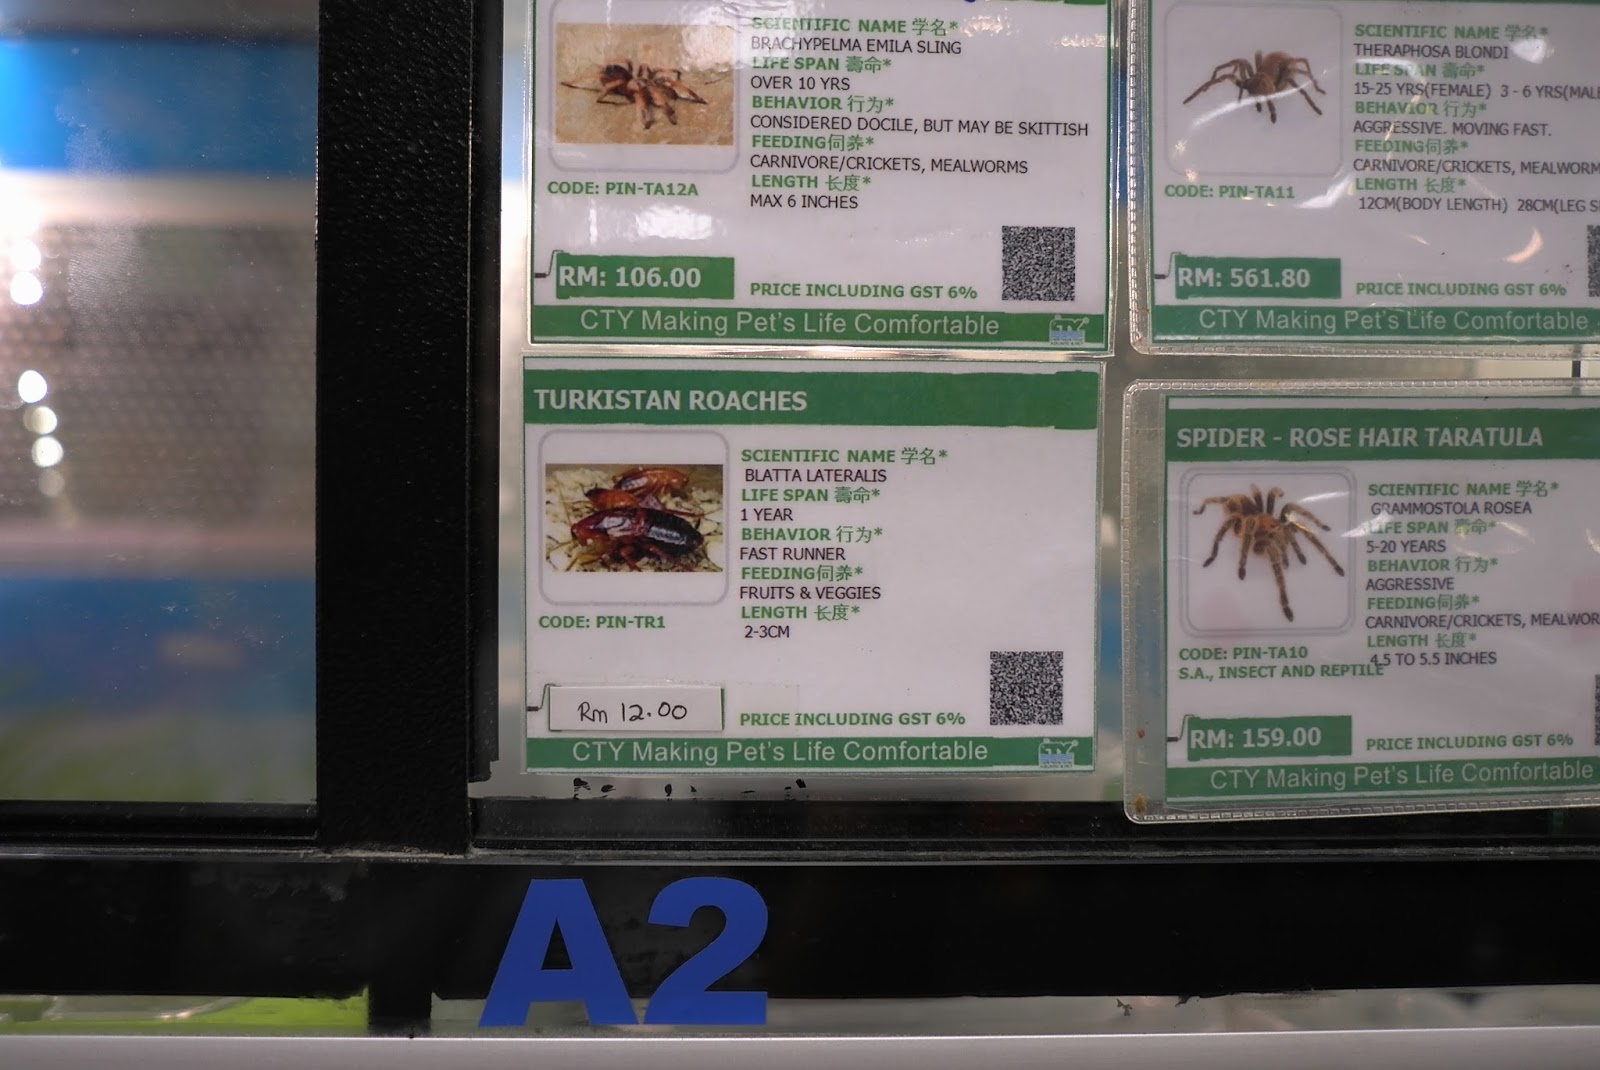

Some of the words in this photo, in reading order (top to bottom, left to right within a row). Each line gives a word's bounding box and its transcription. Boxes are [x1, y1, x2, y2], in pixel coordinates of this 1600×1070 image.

[751, 17, 851, 32] SCIENTIFIC
[858, 21, 907, 33] NAME
[1355, 25, 1447, 38] SCIENTIFIC
[1454, 26, 1499, 39] NAME
[750, 37, 861, 51] BRACHYPELMA
[867, 39, 913, 53] EMILA
[916, 40, 962, 55] SLING
[1353, 43, 1451, 58] THERAPHOSA
[1455, 46, 1509, 59] BLONDI
[752, 57, 789, 69] LIFE
[794, 57, 840, 71] SPAN
[750, 76, 793, 90] OVER
[798, 77, 816, 90] 10
[819, 77, 851, 90] YRS
[1354, 82, 1391, 95] 15-25
[1396, 82, 1492, 98] YRS(FEMALE)
[1500, 85, 1509, 97] 3
[1523, 85, 1531, 97] 6
[752, 96, 842, 110] BEHAVIOR
[1355, 101, 1438, 115] BEHAVIOR
[750, 116, 852, 130] CONSIDERED
[857, 119, 918, 134] DOCILE,
[923, 120, 953, 132] BUT
[957, 121, 989, 134] MAY
[994, 121, 1013, 134] BE
[1018, 122, 1089, 136] SKITTISH
[1353, 120, 1447, 134] AGGRESSIVE.
[1452, 123, 1509, 135] MOVING
[1513, 124, 1552, 136] FAST.
[750, 155, 926, 174] CARNIVORE/CRICKETS,
[931, 160, 1029, 174] MEALWORMS
[1353, 159, 1515, 176] CARNIVORE/CRICKETS,
[1520, 161, 1600, 175] MEALWORM
[547, 182, 599, 195] CODE:
[605, 182, 699, 195] PIN-TA12A
[751, 175, 819, 188] LENGTH
[1356, 178, 1418, 191] LENGTH
[1164, 184, 1214, 198] CODE:
[1218, 185, 1295, 199] PIN-TA11
[750, 195, 783, 208] MAX
[787, 195, 797, 208] 6
[801, 195, 859, 209] INCHES
[1359, 196, 1441, 212] 12CM(BODY
[1447, 198, 1508, 213] LENGTH)
[1518, 199, 1585, 213] 28CM(LEG
[558, 267, 606, 288] RM:
[615, 267, 702, 288] 106.00
[1177, 269, 1223, 288] RM:
[1230, 269, 1311, 289] 561.80
[750, 283, 802, 298] PRICE
[805, 284, 907, 300] INCLUDING
[910, 285, 944, 300] GST
[948, 285, 978, 301] 6%
[1356, 283, 1403, 294] PRICE
[1407, 283, 1502, 295] INCLUDING
[1504, 283, 1536, 296] GST
[1539, 283, 1567, 296] 6%
[580, 310, 635, 331] CTY
[641, 310, 729, 336] Making
[803, 312, 846, 334] Life
[853, 313, 999, 336] Comfortable
[1199, 310, 1247, 330] CTY
[1255, 310, 1336, 334] Making
[1407, 311, 1447, 330] Life
[1453, 311, 1588, 331] Comfortable
[534, 389, 680, 410] TURKISTAN
[689, 390, 808, 412] ROACHES
[1177, 428, 1267, 448] SPIDER
[1290, 428, 1352, 448] ROSE
[1359, 427, 1419, 447] HAIR
[1424, 427, 1544, 447] TARATULA
[741, 450, 840, 462] SCIENTIFIC
[847, 450, 895, 463] NAME
[746, 469, 802, 482] BLATTA
[806, 469, 887, 482] LATERALIS
[741, 489, 778, 501] LIFE
[783, 489, 828, 502] SPAN
[1368, 483, 1459, 496] SCIENTIFIC
[1467, 483, 1511, 495] NAME
[741, 509, 748, 521] 1
[753, 509, 793, 521] YEAR
[1371, 501, 1480, 515] GRAMMOSTOLA
[1484, 501, 1532, 514] ROSEA
[741, 528, 831, 541] BEHAVIOR
[1407, 521, 1449, 534] SPAN
[1366, 540, 1397, 553] 5-20
[1401, 540, 1446, 552] YEARS
[740, 548, 778, 560] FAST
[783, 548, 846, 560] RUNNER
[1368, 558, 1450, 572] BEHAVIOR
[1366, 577, 1455, 591] AGGRESSIVE
[740, 586, 794, 599] FRUITS
[800, 586, 811, 599] &
[815, 586, 881, 599] VEGGIES
[741, 606, 807, 618] LENGTH
[538, 615, 591, 629] CODE:
[596, 615, 666, 629] PIN-TR1
[1365, 614, 1526, 630] CARNIVORE/CRICKETS,
[745, 626, 790, 638] 2-3CM
[1367, 634, 1429, 647] LENGTH
[1179, 648, 1228, 660] CODE:
[1233, 646, 1308, 660] PIN-TA10
[1370, 654, 1391, 666] 4.5
[1395, 653, 1415, 665] TO
[1420, 652, 1440, 665] 5.5
[1445, 651, 1497, 665] INCHES
[1179, 666, 1214, 682] S.A.,
[1219, 666, 1276, 679] INSECT
[1281, 665, 1315, 678] AND
[1320, 664, 1384, 677] REPTILE
[619, 701, 689, 724] 12.00
[739, 712, 790, 726] PRICE
[795, 712, 893, 726] INCLUDING
[898, 712, 932, 726] GST
[936, 712, 966, 726] 6%
[1190, 729, 1234, 748] RM:
[1242, 727, 1322, 747] 159.00
[1366, 737, 1412, 751] PRICE
[1417, 735, 1507, 750] INCLUDING
[1511, 734, 1542, 747] GST
[1547, 733, 1574, 747] 6%
[572, 741, 626, 762] CTY
[632, 741, 719, 768] Making
[793, 741, 837, 761] Life
[843, 741, 988, 761] Comfortable
[1210, 769, 1259, 790] CTY
[1266, 767, 1347, 792] Making
[1414, 764, 1455, 784] Life
[1461, 761, 1594, 783] Comfortable
[478, 876, 769, 1028] A2
